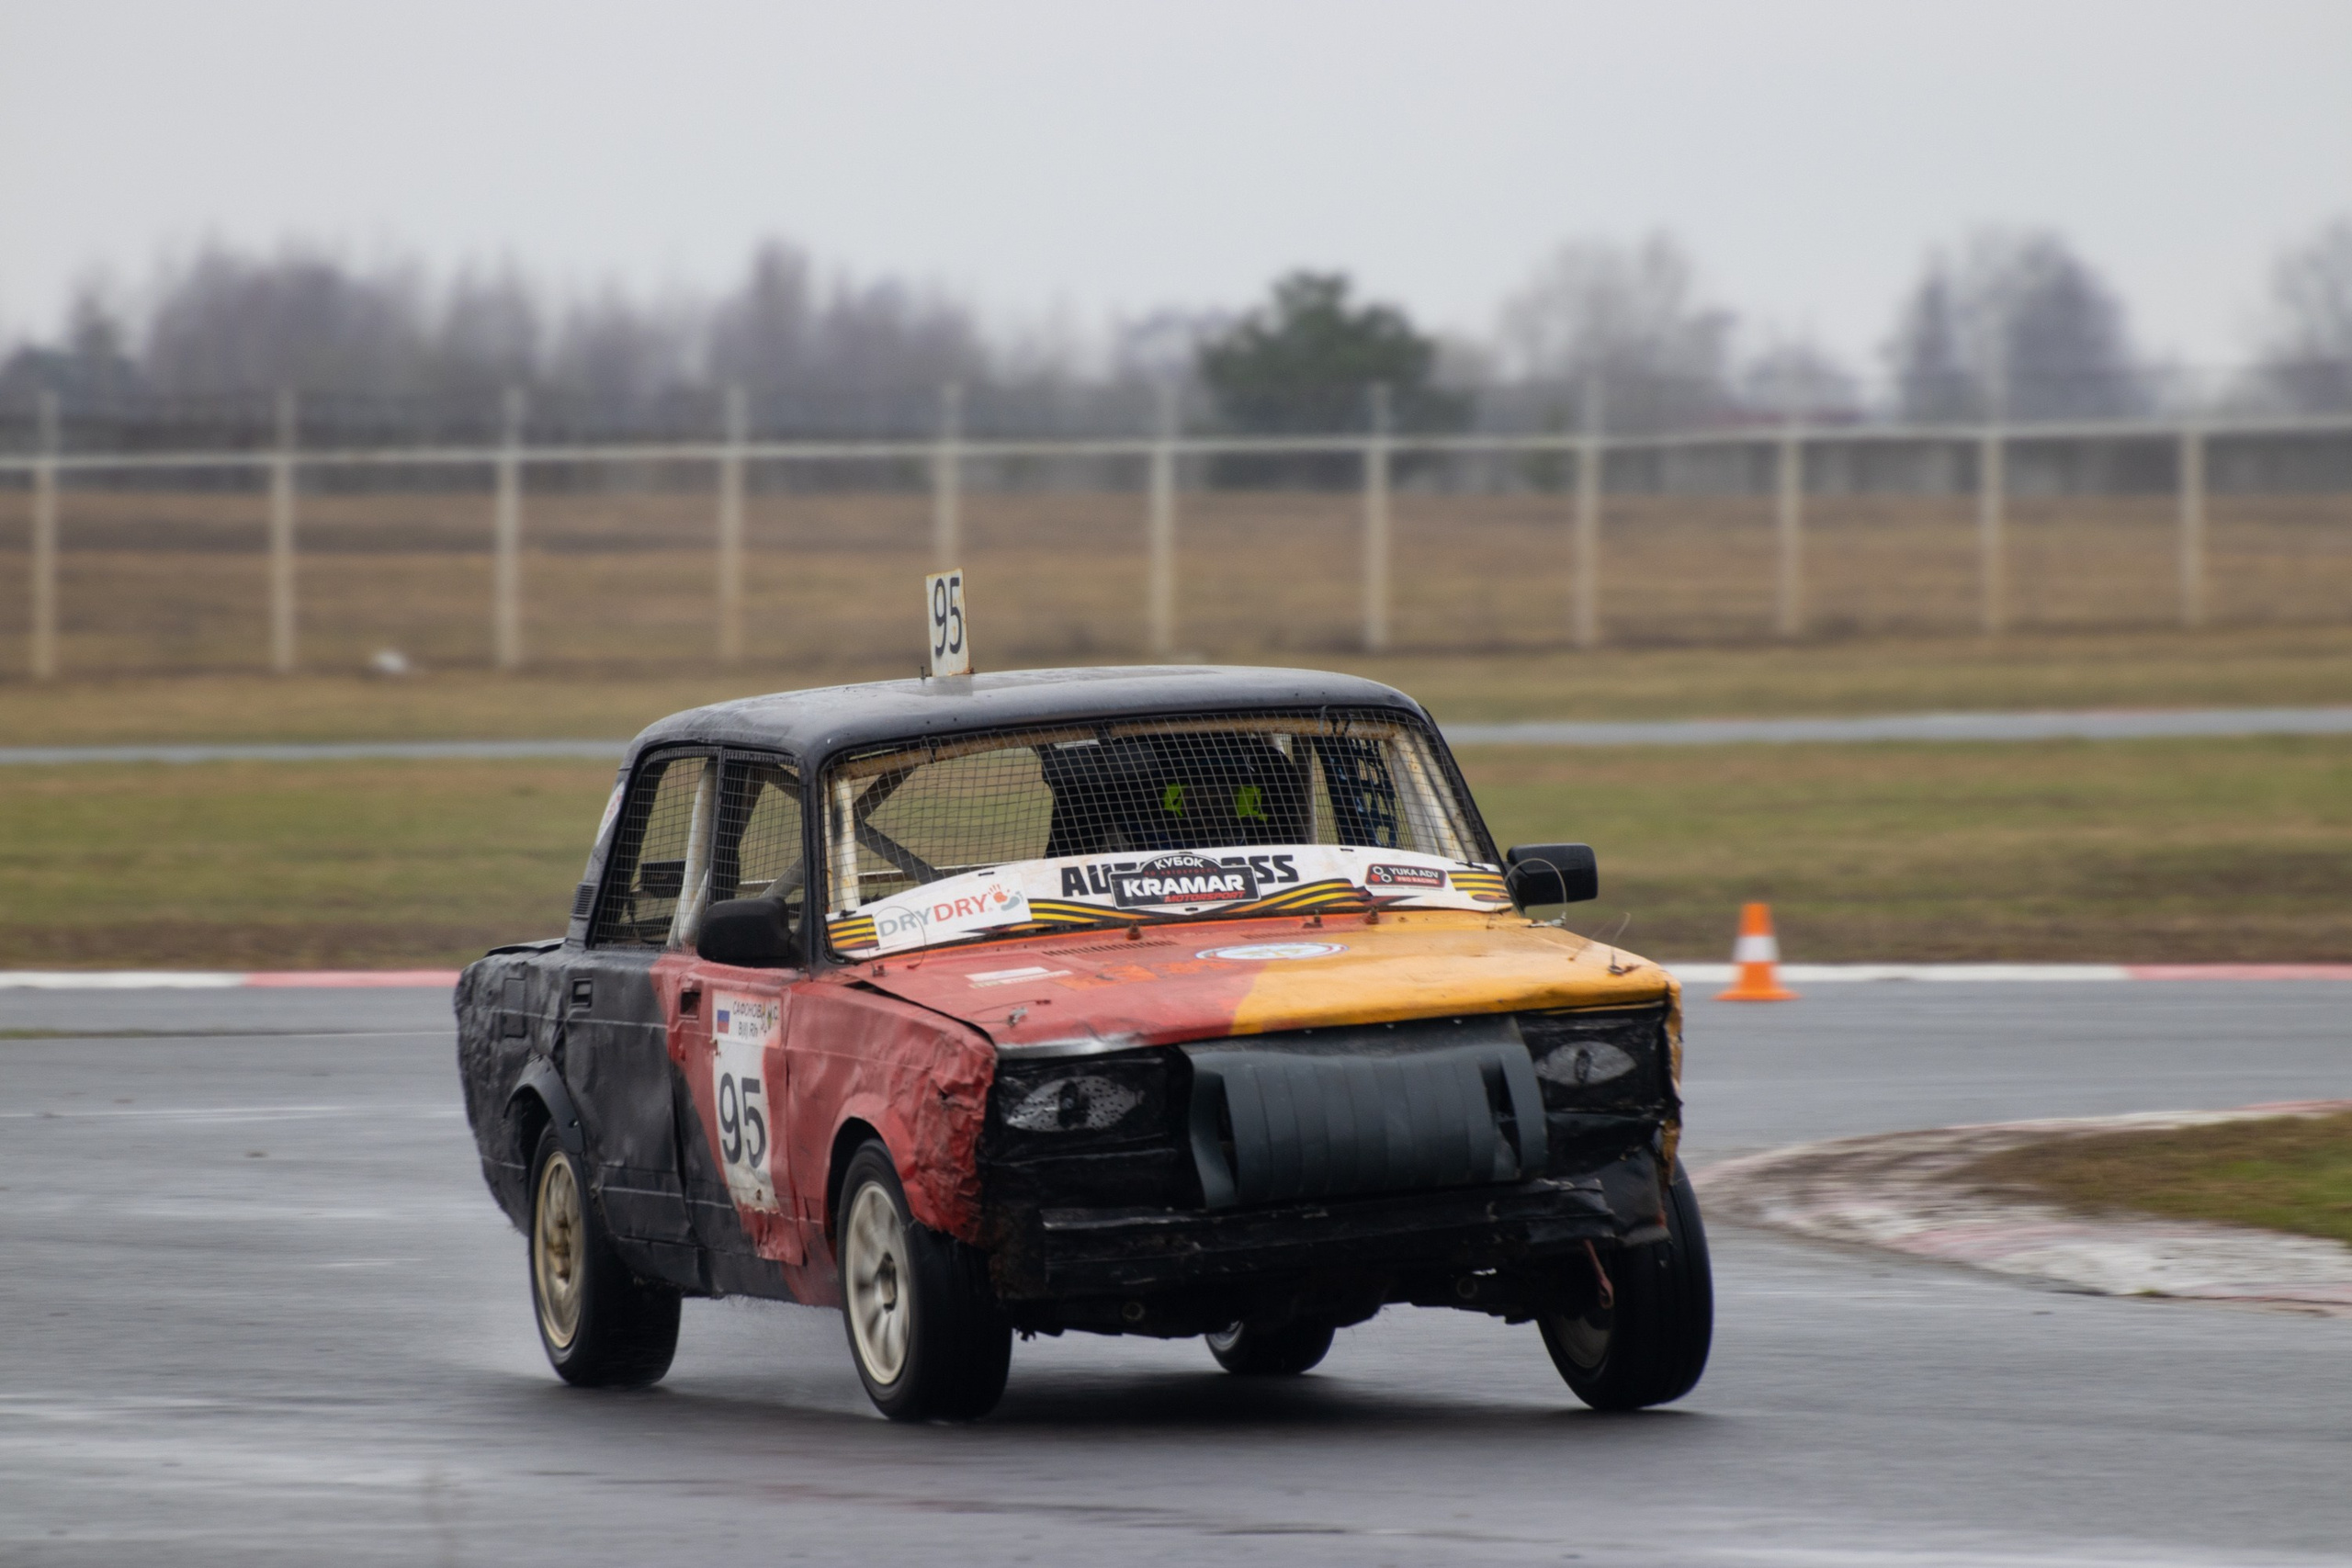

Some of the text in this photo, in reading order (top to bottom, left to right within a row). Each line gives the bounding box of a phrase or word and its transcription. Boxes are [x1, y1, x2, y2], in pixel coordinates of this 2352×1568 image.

[934, 577, 962, 657] 95
[1153, 856, 1204, 870] КУБОК
[1388, 867, 1439, 878] YUKA ADV
[1123, 874, 1245, 897] KRAMAR
[1164, 890, 1246, 903] MOTORSPORT
[718, 1072, 766, 1169] 95
